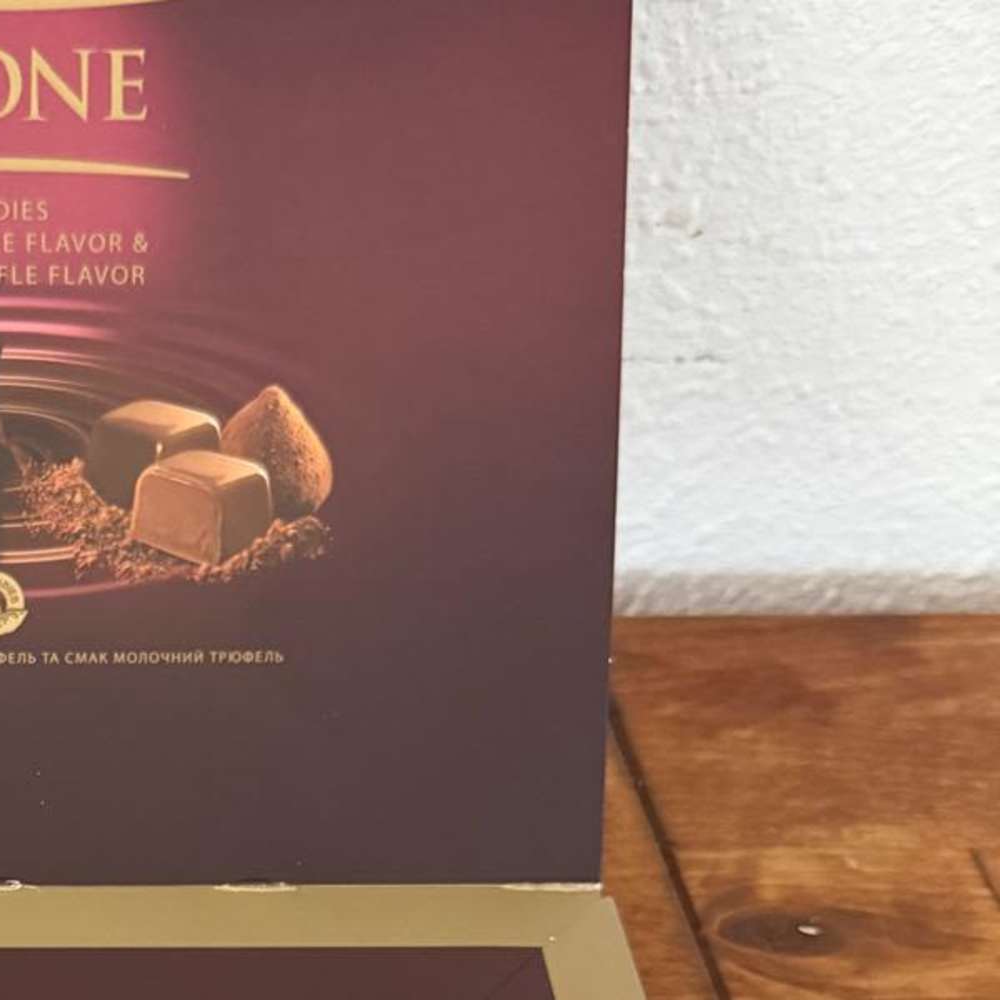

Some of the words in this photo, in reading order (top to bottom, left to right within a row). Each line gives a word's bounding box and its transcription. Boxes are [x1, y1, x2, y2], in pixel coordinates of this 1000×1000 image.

[25, 232, 123, 254] FLAVOR
[132, 232, 150, 254] &
[48, 264, 147, 286] FLAVOR
[40, 652, 60, 665] ТА
[63, 651, 110, 665] СМАК
[113, 649, 204, 665] МОЛОЧНИЙ
[208, 650, 285, 664] ТРЮФЕЛЬ
